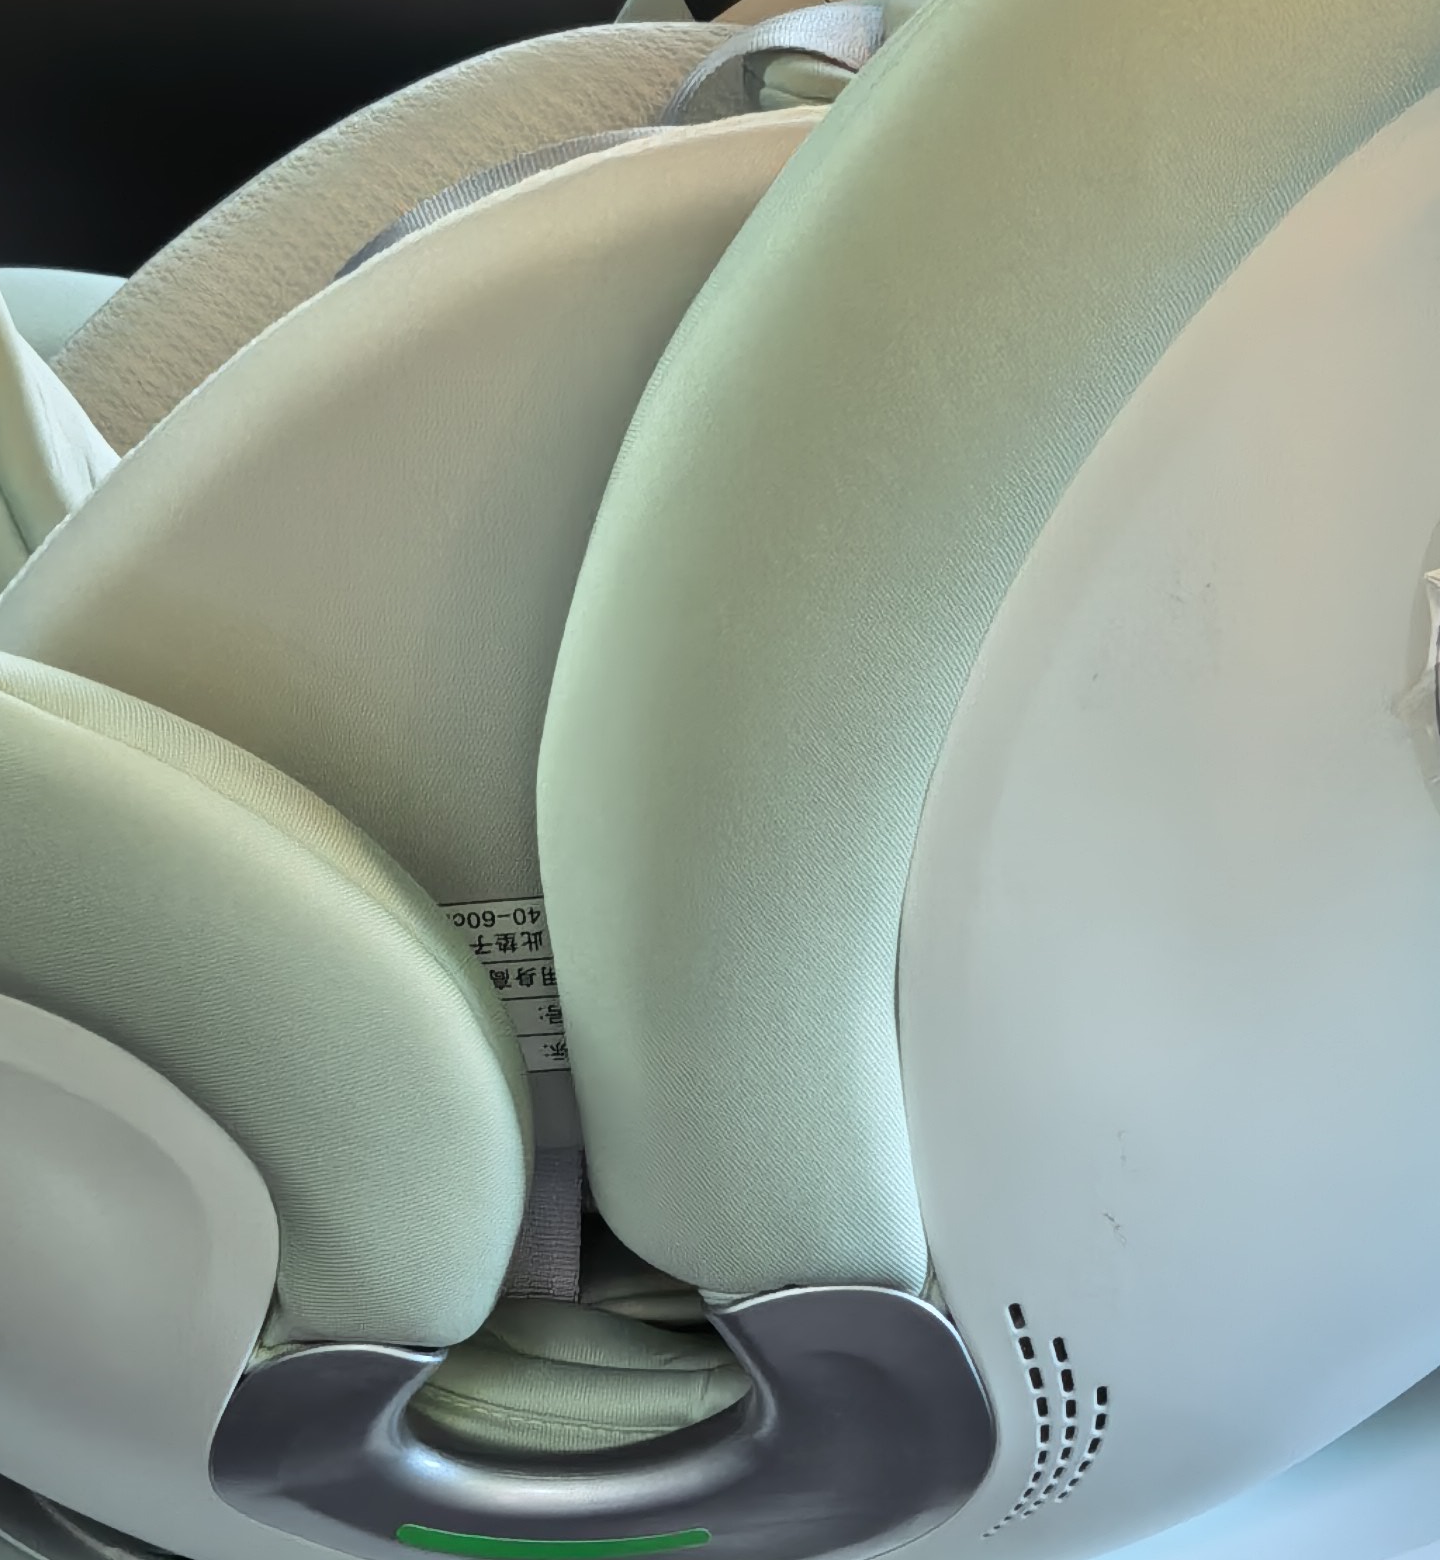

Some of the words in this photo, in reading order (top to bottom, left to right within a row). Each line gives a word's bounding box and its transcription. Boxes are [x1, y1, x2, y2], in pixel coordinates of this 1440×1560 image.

[447, 906, 542, 930] 40-60c
[469, 930, 544, 955] 此垫子
